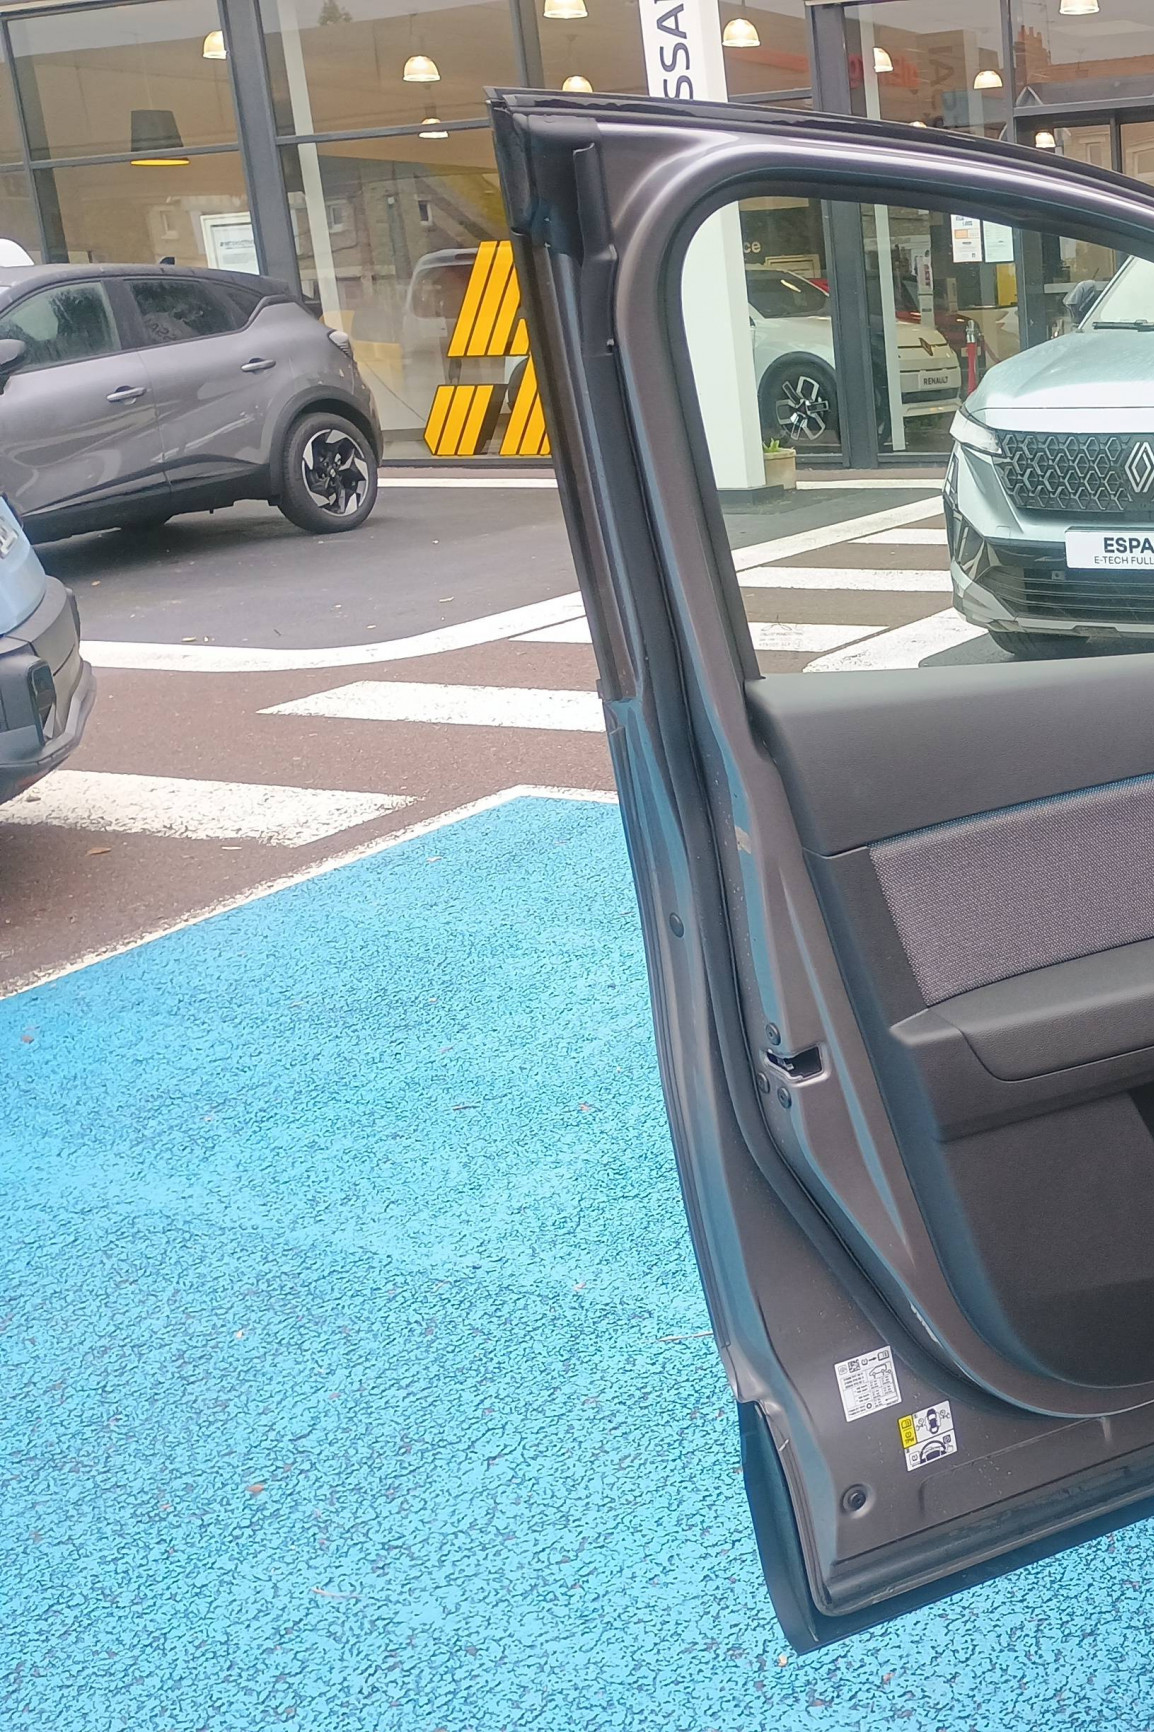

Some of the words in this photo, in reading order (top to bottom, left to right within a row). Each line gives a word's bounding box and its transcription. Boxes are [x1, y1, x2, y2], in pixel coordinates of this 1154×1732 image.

[656, 0, 694, 100] SSA
[1094, 556, 1129, 565] E-TECH
[1131, 556, 1154, 565] FULL
